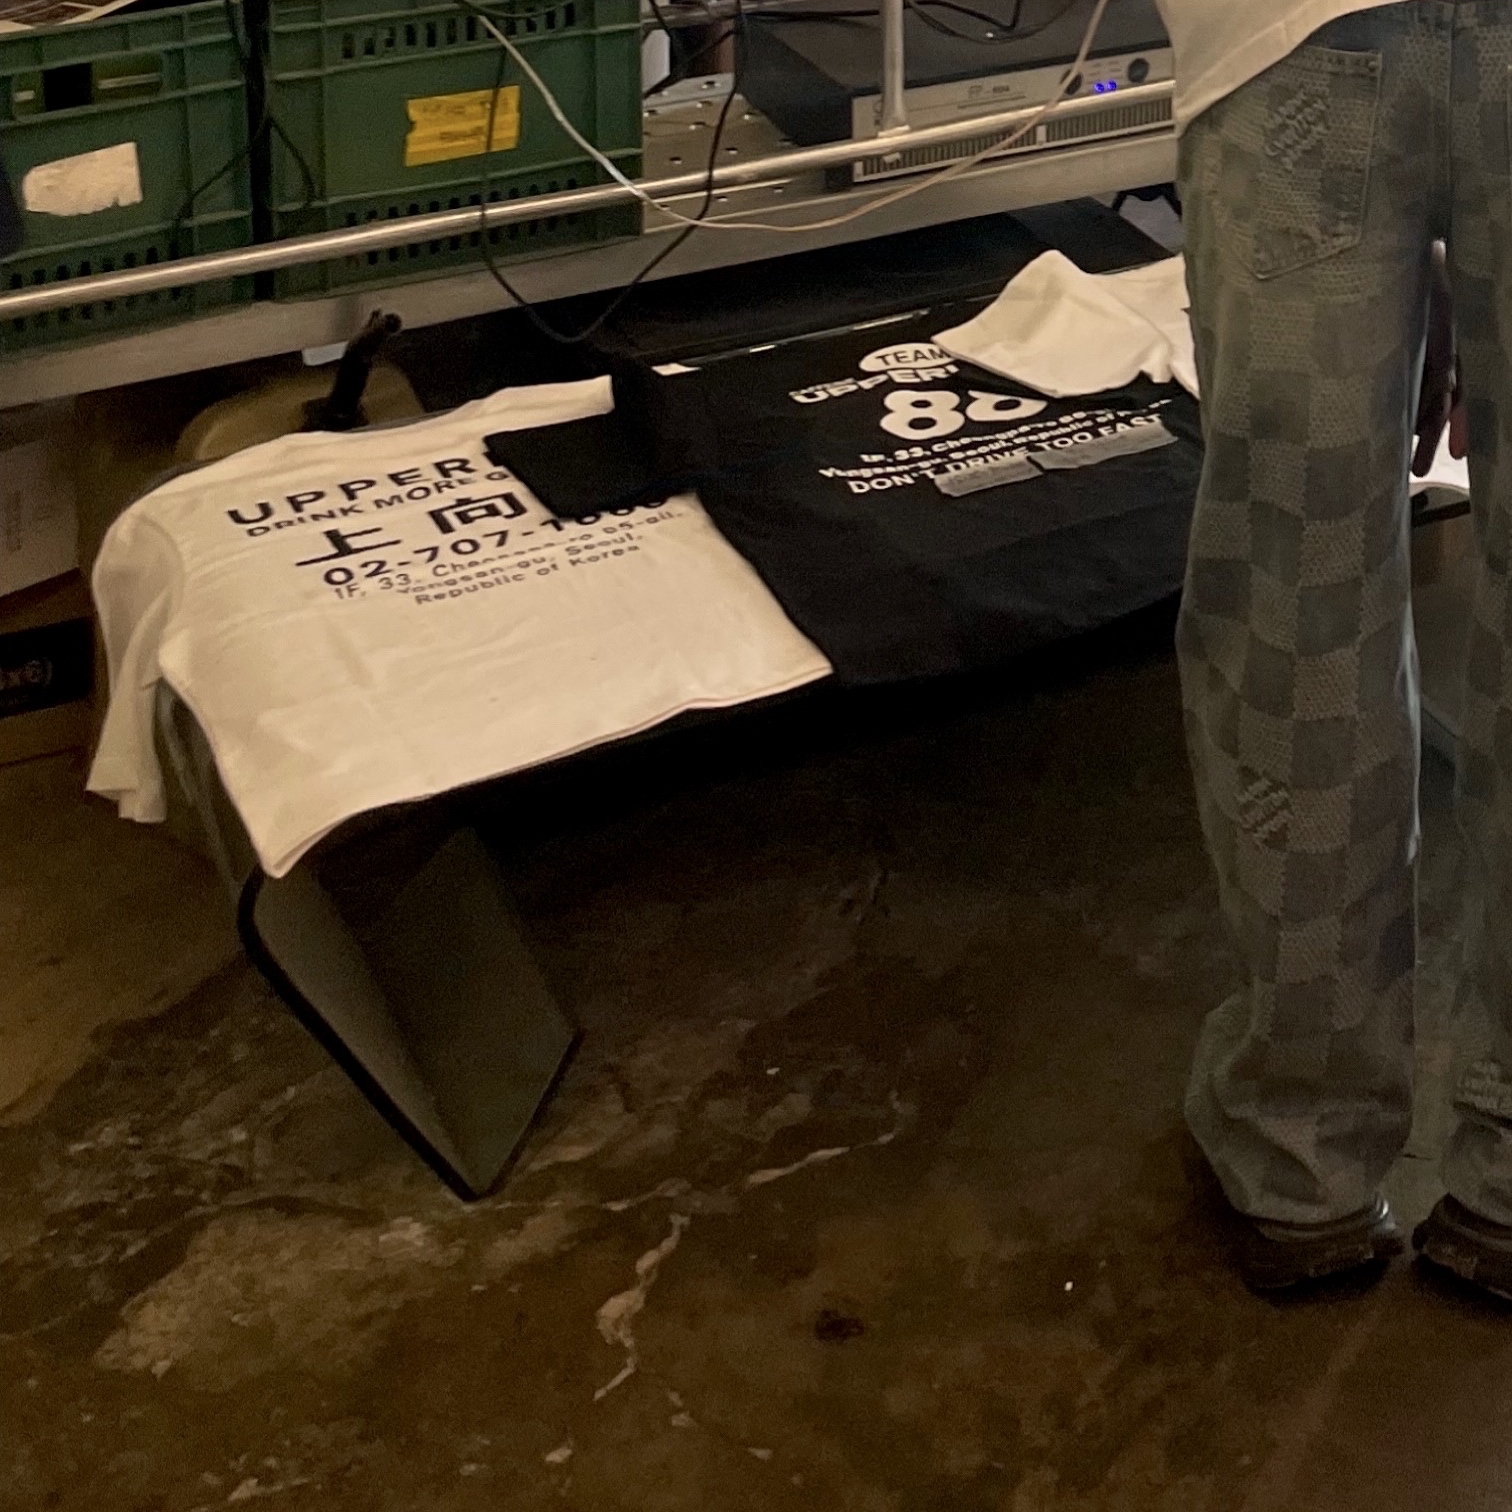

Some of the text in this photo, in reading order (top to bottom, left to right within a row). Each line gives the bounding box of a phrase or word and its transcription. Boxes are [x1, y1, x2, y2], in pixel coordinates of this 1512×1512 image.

[876, 347, 954, 367] TEAM
[847, 467, 936, 494] DON'T
[944, 445, 1030, 474] DRIVE
[1034, 430, 1094, 453] TOO
[1097, 413, 1162, 437] FAST
[246, 503, 364, 538] DRINK
[372, 476, 478, 510] MORE
[414, 543, 641, 606] Republic of Korea
